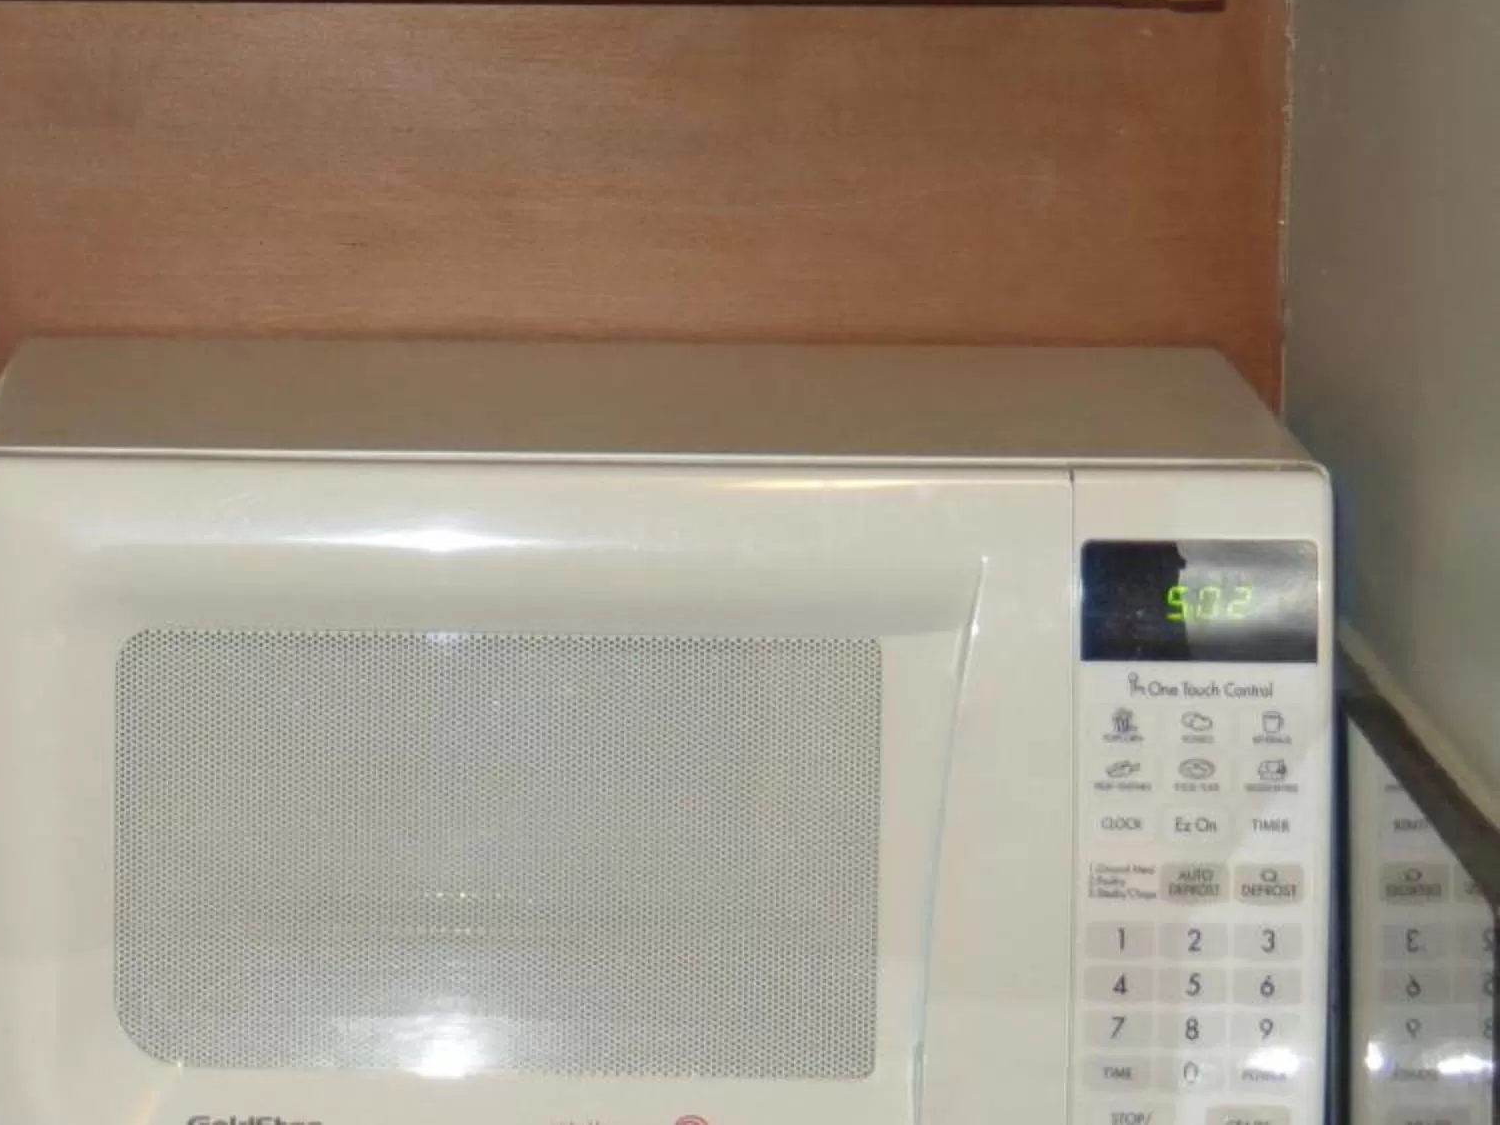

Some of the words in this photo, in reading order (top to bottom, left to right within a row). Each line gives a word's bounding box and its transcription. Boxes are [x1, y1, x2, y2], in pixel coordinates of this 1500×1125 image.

[1147, 679, 1178, 697] One
[1183, 680, 1219, 696] Touch
[1223, 681, 1274, 698] Control
[1100, 817, 1143, 830] CLOCK
[1174, 816, 1191, 832] Ez
[1195, 817, 1217, 832] On
[1251, 818, 1291, 832] TIMER
[1116, 927, 1126, 951] 1
[1187, 928, 1201, 952] 2
[1260, 929, 1276, 953] 3
[1112, 972, 1128, 995] 4
[1185, 972, 1201, 996] 5
[1260, 974, 1275, 997] 6
[1110, 1016, 1126, 1039] 7
[1184, 1017, 1200, 1041] 8
[1258, 1018, 1274, 1039] 9
